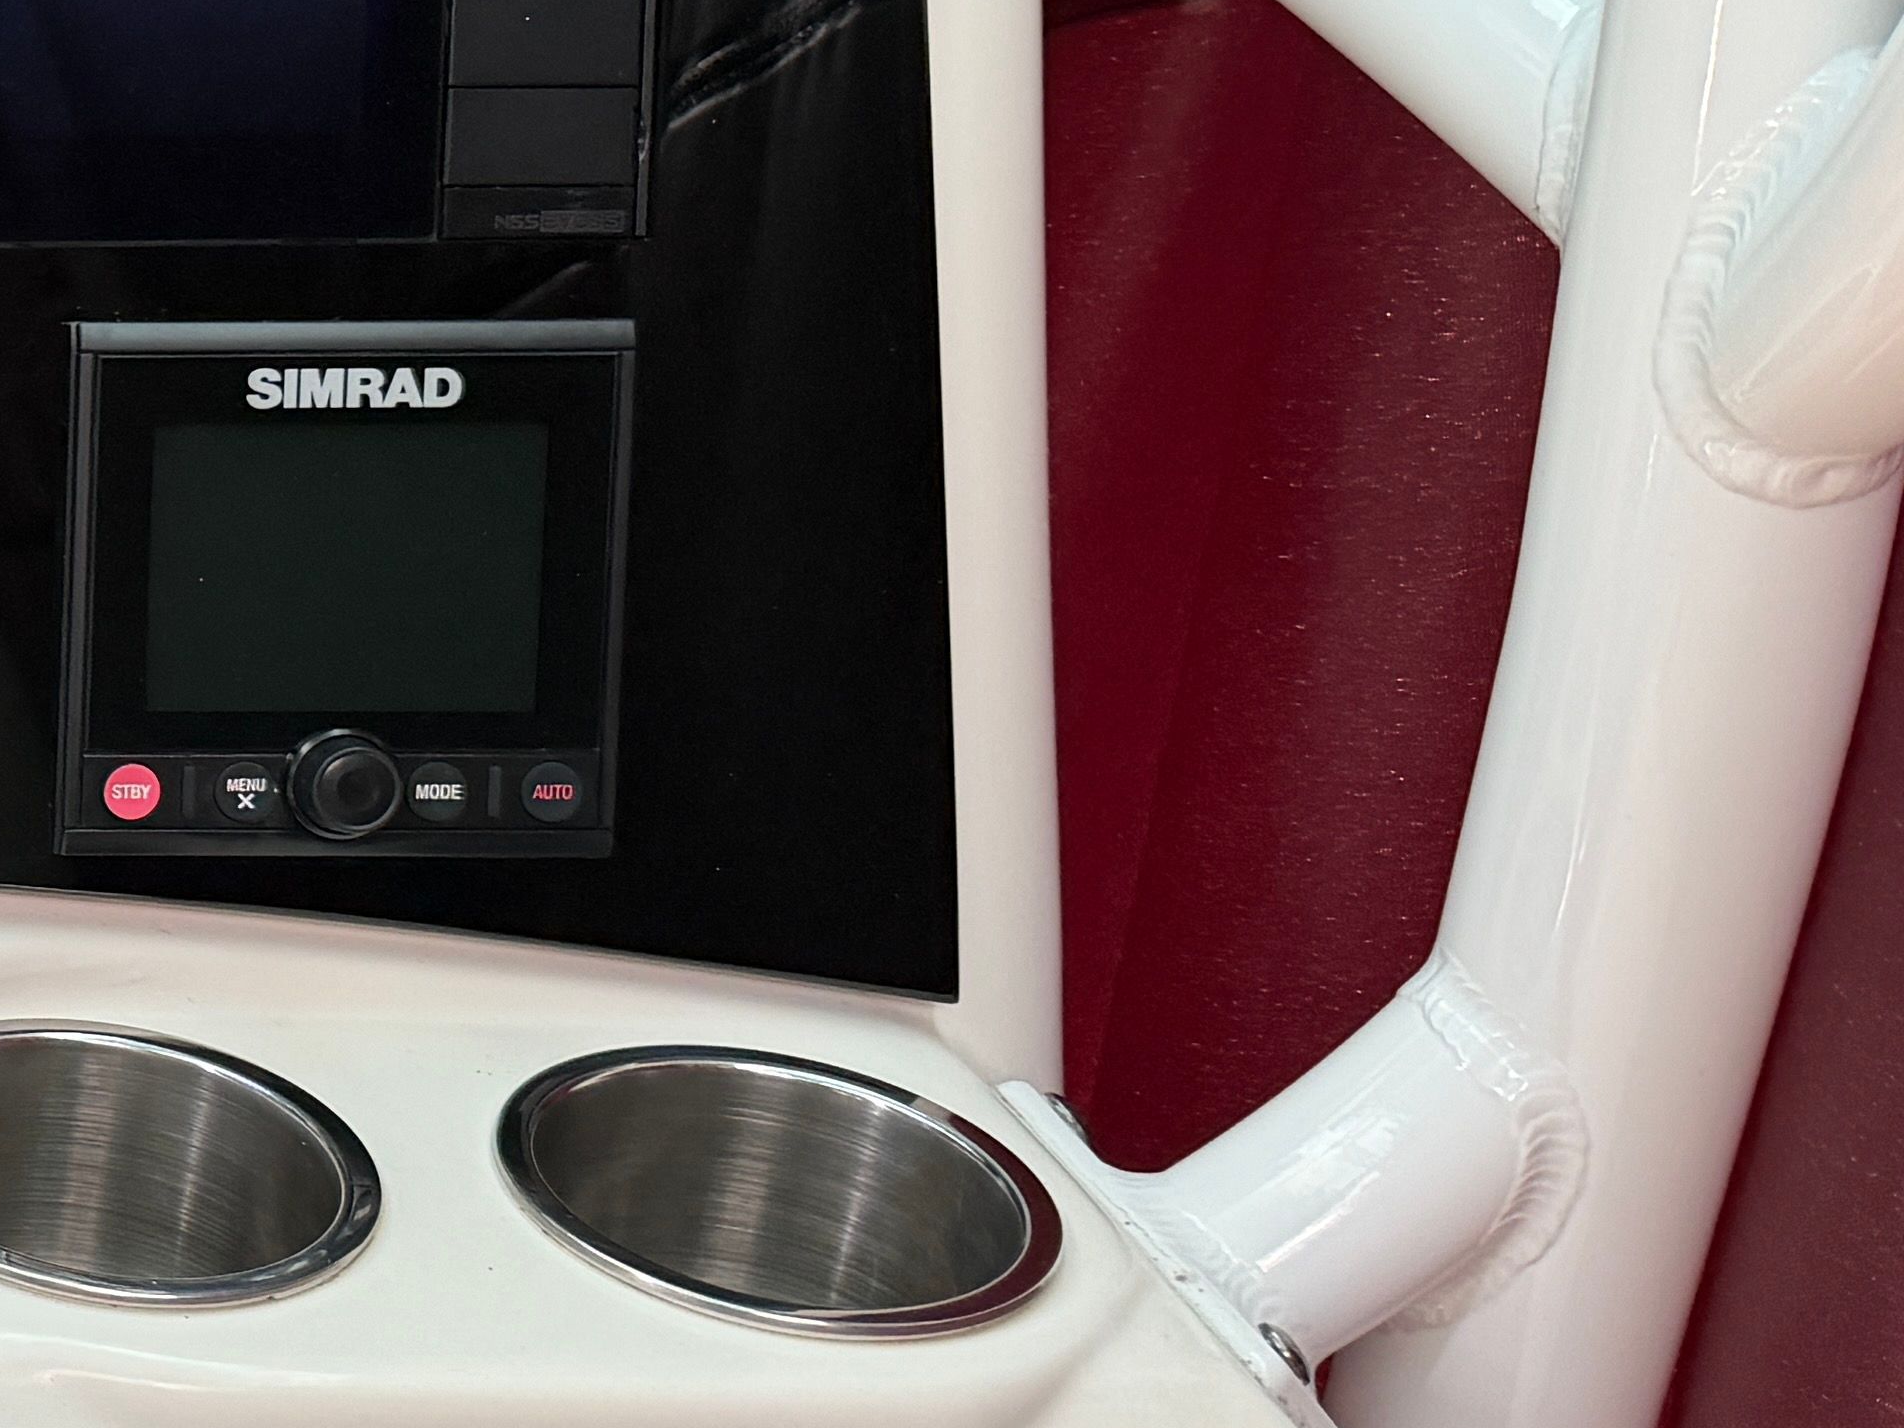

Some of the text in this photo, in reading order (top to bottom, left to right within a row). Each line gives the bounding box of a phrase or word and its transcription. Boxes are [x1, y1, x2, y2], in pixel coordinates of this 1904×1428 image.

[246, 368, 462, 409] SIMRAD
[111, 782, 151, 801] STBY
[226, 778, 266, 793] MENU
[415, 783, 463, 800] MODE
[532, 783, 573, 800] AUTO
